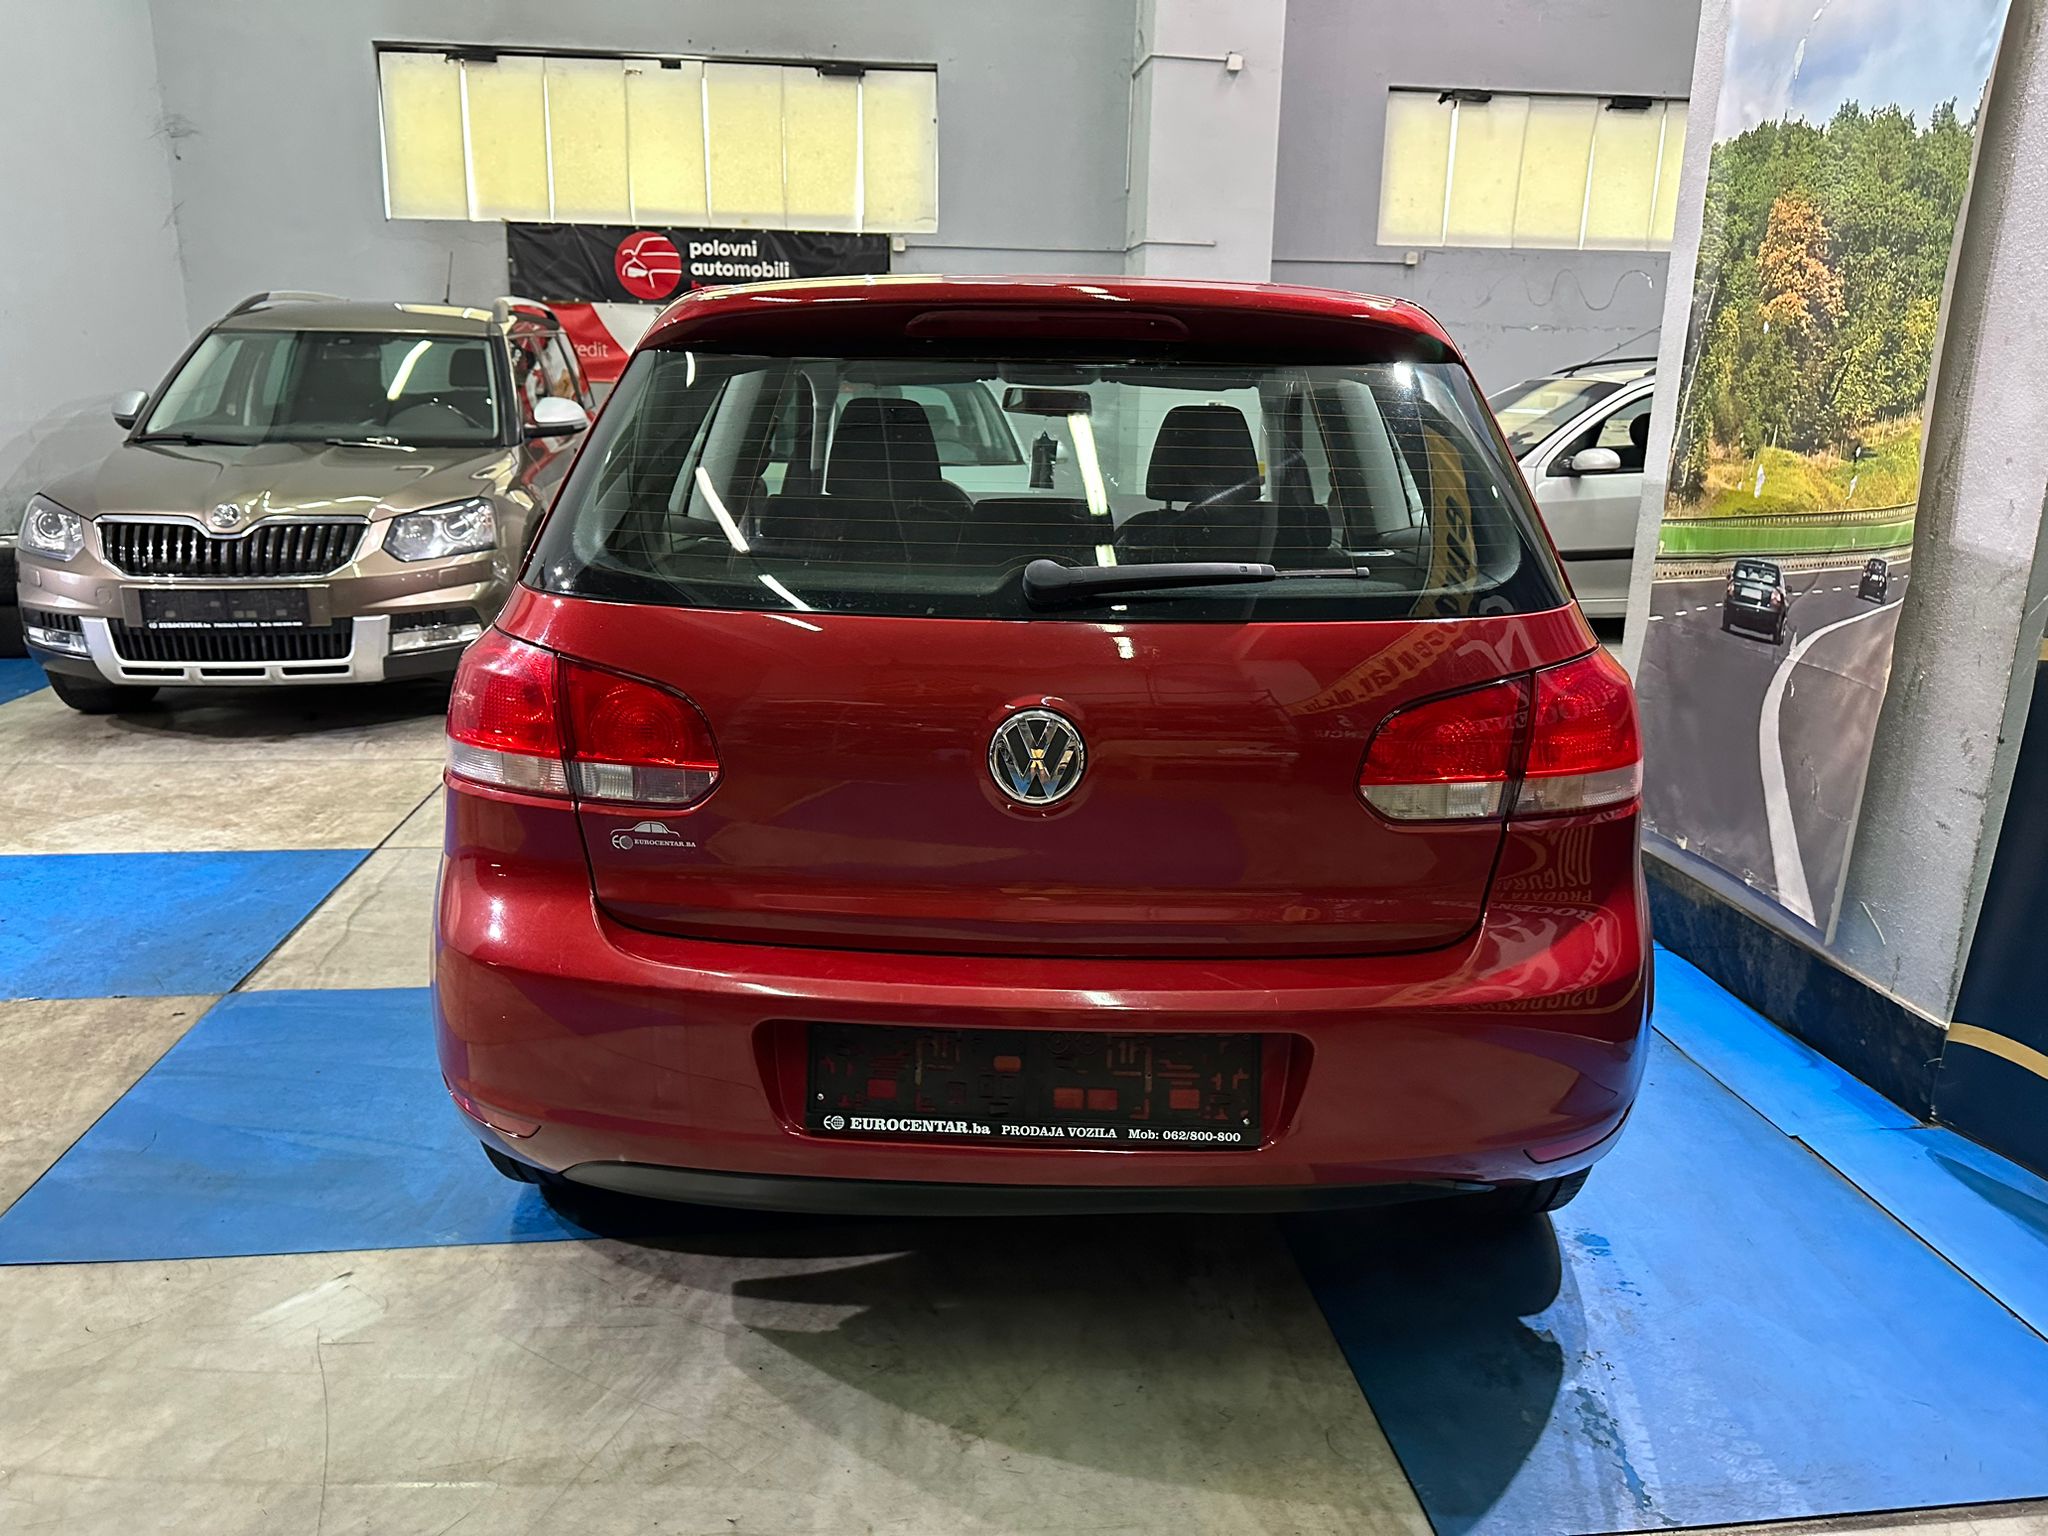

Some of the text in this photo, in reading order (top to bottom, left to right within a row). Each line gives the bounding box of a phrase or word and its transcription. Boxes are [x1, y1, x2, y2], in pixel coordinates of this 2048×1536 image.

[688, 239, 758, 259] polovni
[690, 261, 790, 278] automobili
[850, 1117, 991, 1135] EUROCENTAR.ba
[1001, 1124, 1065, 1137] PRODAJA
[1067, 1126, 1118, 1139] VOZILA
[1128, 1128, 1160, 1140] Mob:
[1162, 1130, 1241, 1142] 062/800-800
